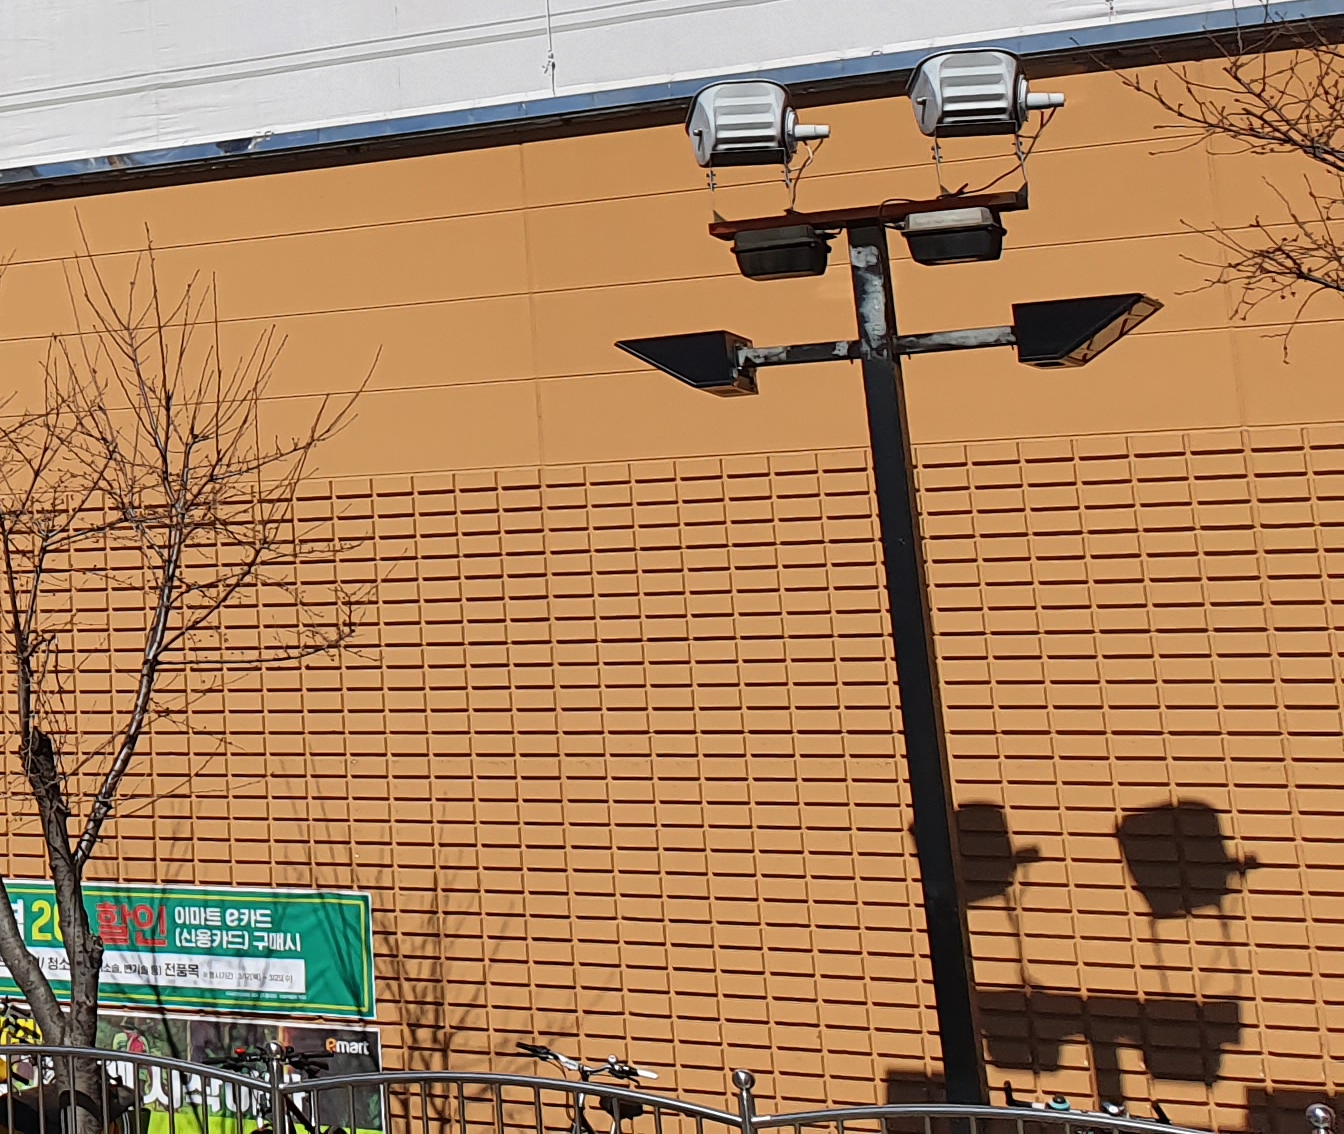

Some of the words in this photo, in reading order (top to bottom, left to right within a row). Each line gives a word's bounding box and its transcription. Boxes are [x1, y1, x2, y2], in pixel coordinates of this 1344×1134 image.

[96, 901, 168, 947] 할인
[174, 906, 222, 927] 이마트
[225, 908, 273, 928] e카드
[175, 929, 250, 950] (신용카드)
[252, 932, 302, 953] 구매시
[164, 962, 200, 978] 전품목
[325, 1037, 370, 1055] emart
